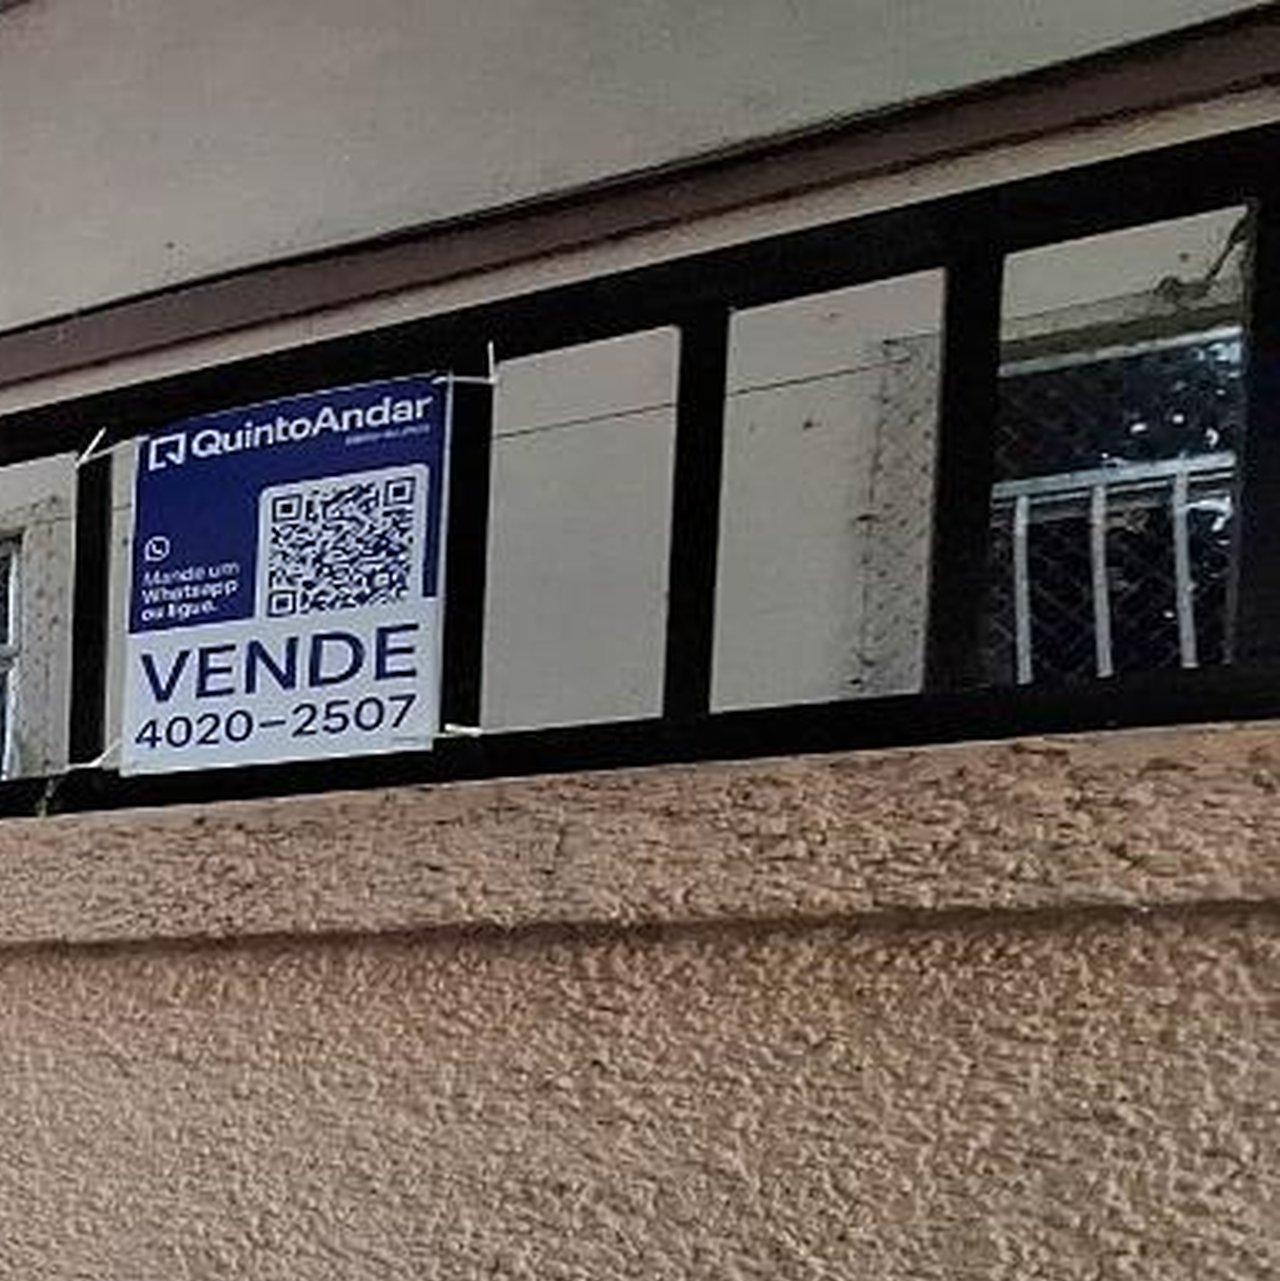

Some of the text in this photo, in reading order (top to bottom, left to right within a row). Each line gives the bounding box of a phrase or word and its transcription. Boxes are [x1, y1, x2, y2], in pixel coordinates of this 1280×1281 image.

[191, 396, 433, 459] QuintoAndar
[142, 623, 419, 702] VENDE
[135, 693, 417, 749] 4020-2507
